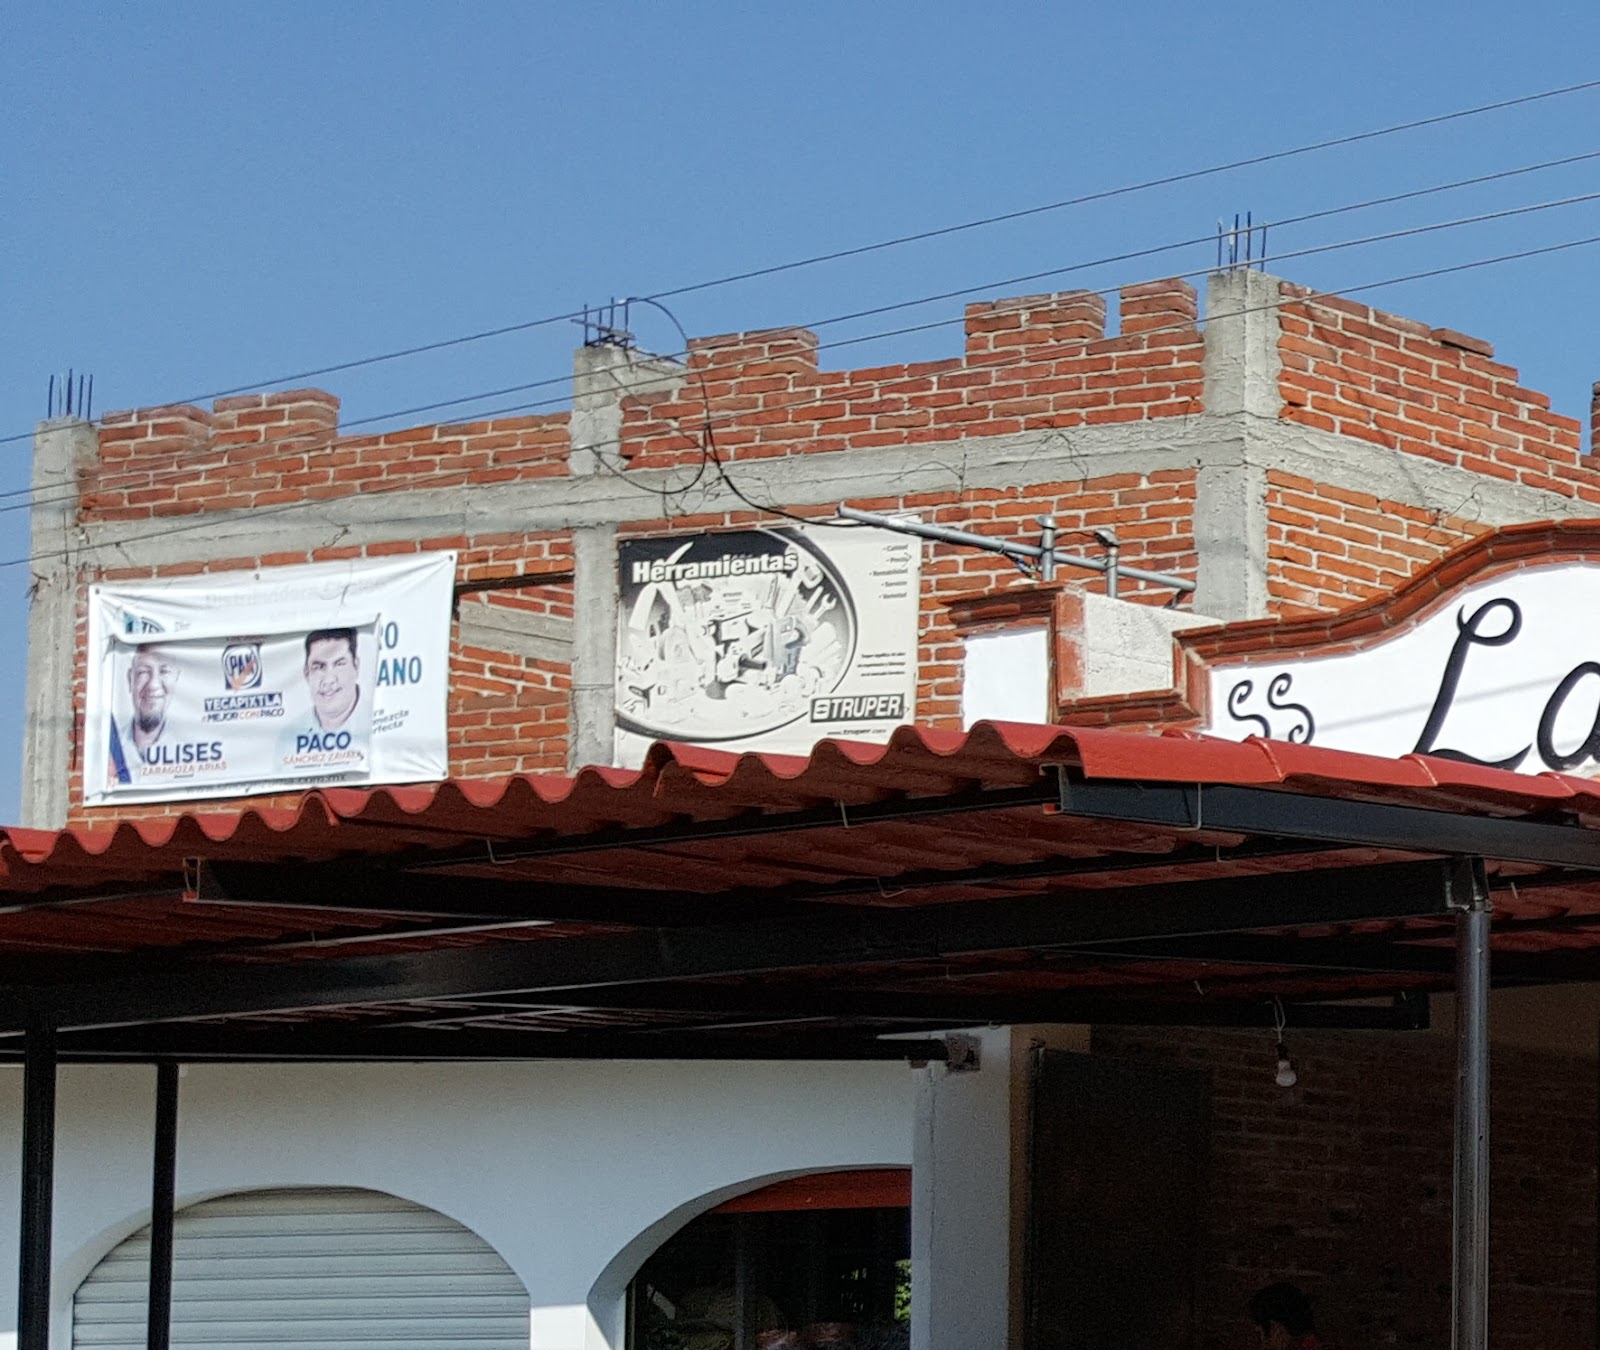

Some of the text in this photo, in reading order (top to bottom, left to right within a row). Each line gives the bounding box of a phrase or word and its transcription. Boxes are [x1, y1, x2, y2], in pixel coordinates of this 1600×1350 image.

[632, 553, 799, 584] Herramientas
[831, 695, 902, 719] TRUPER
[146, 741, 223, 765] ULISES
[297, 731, 352, 754] PACO
